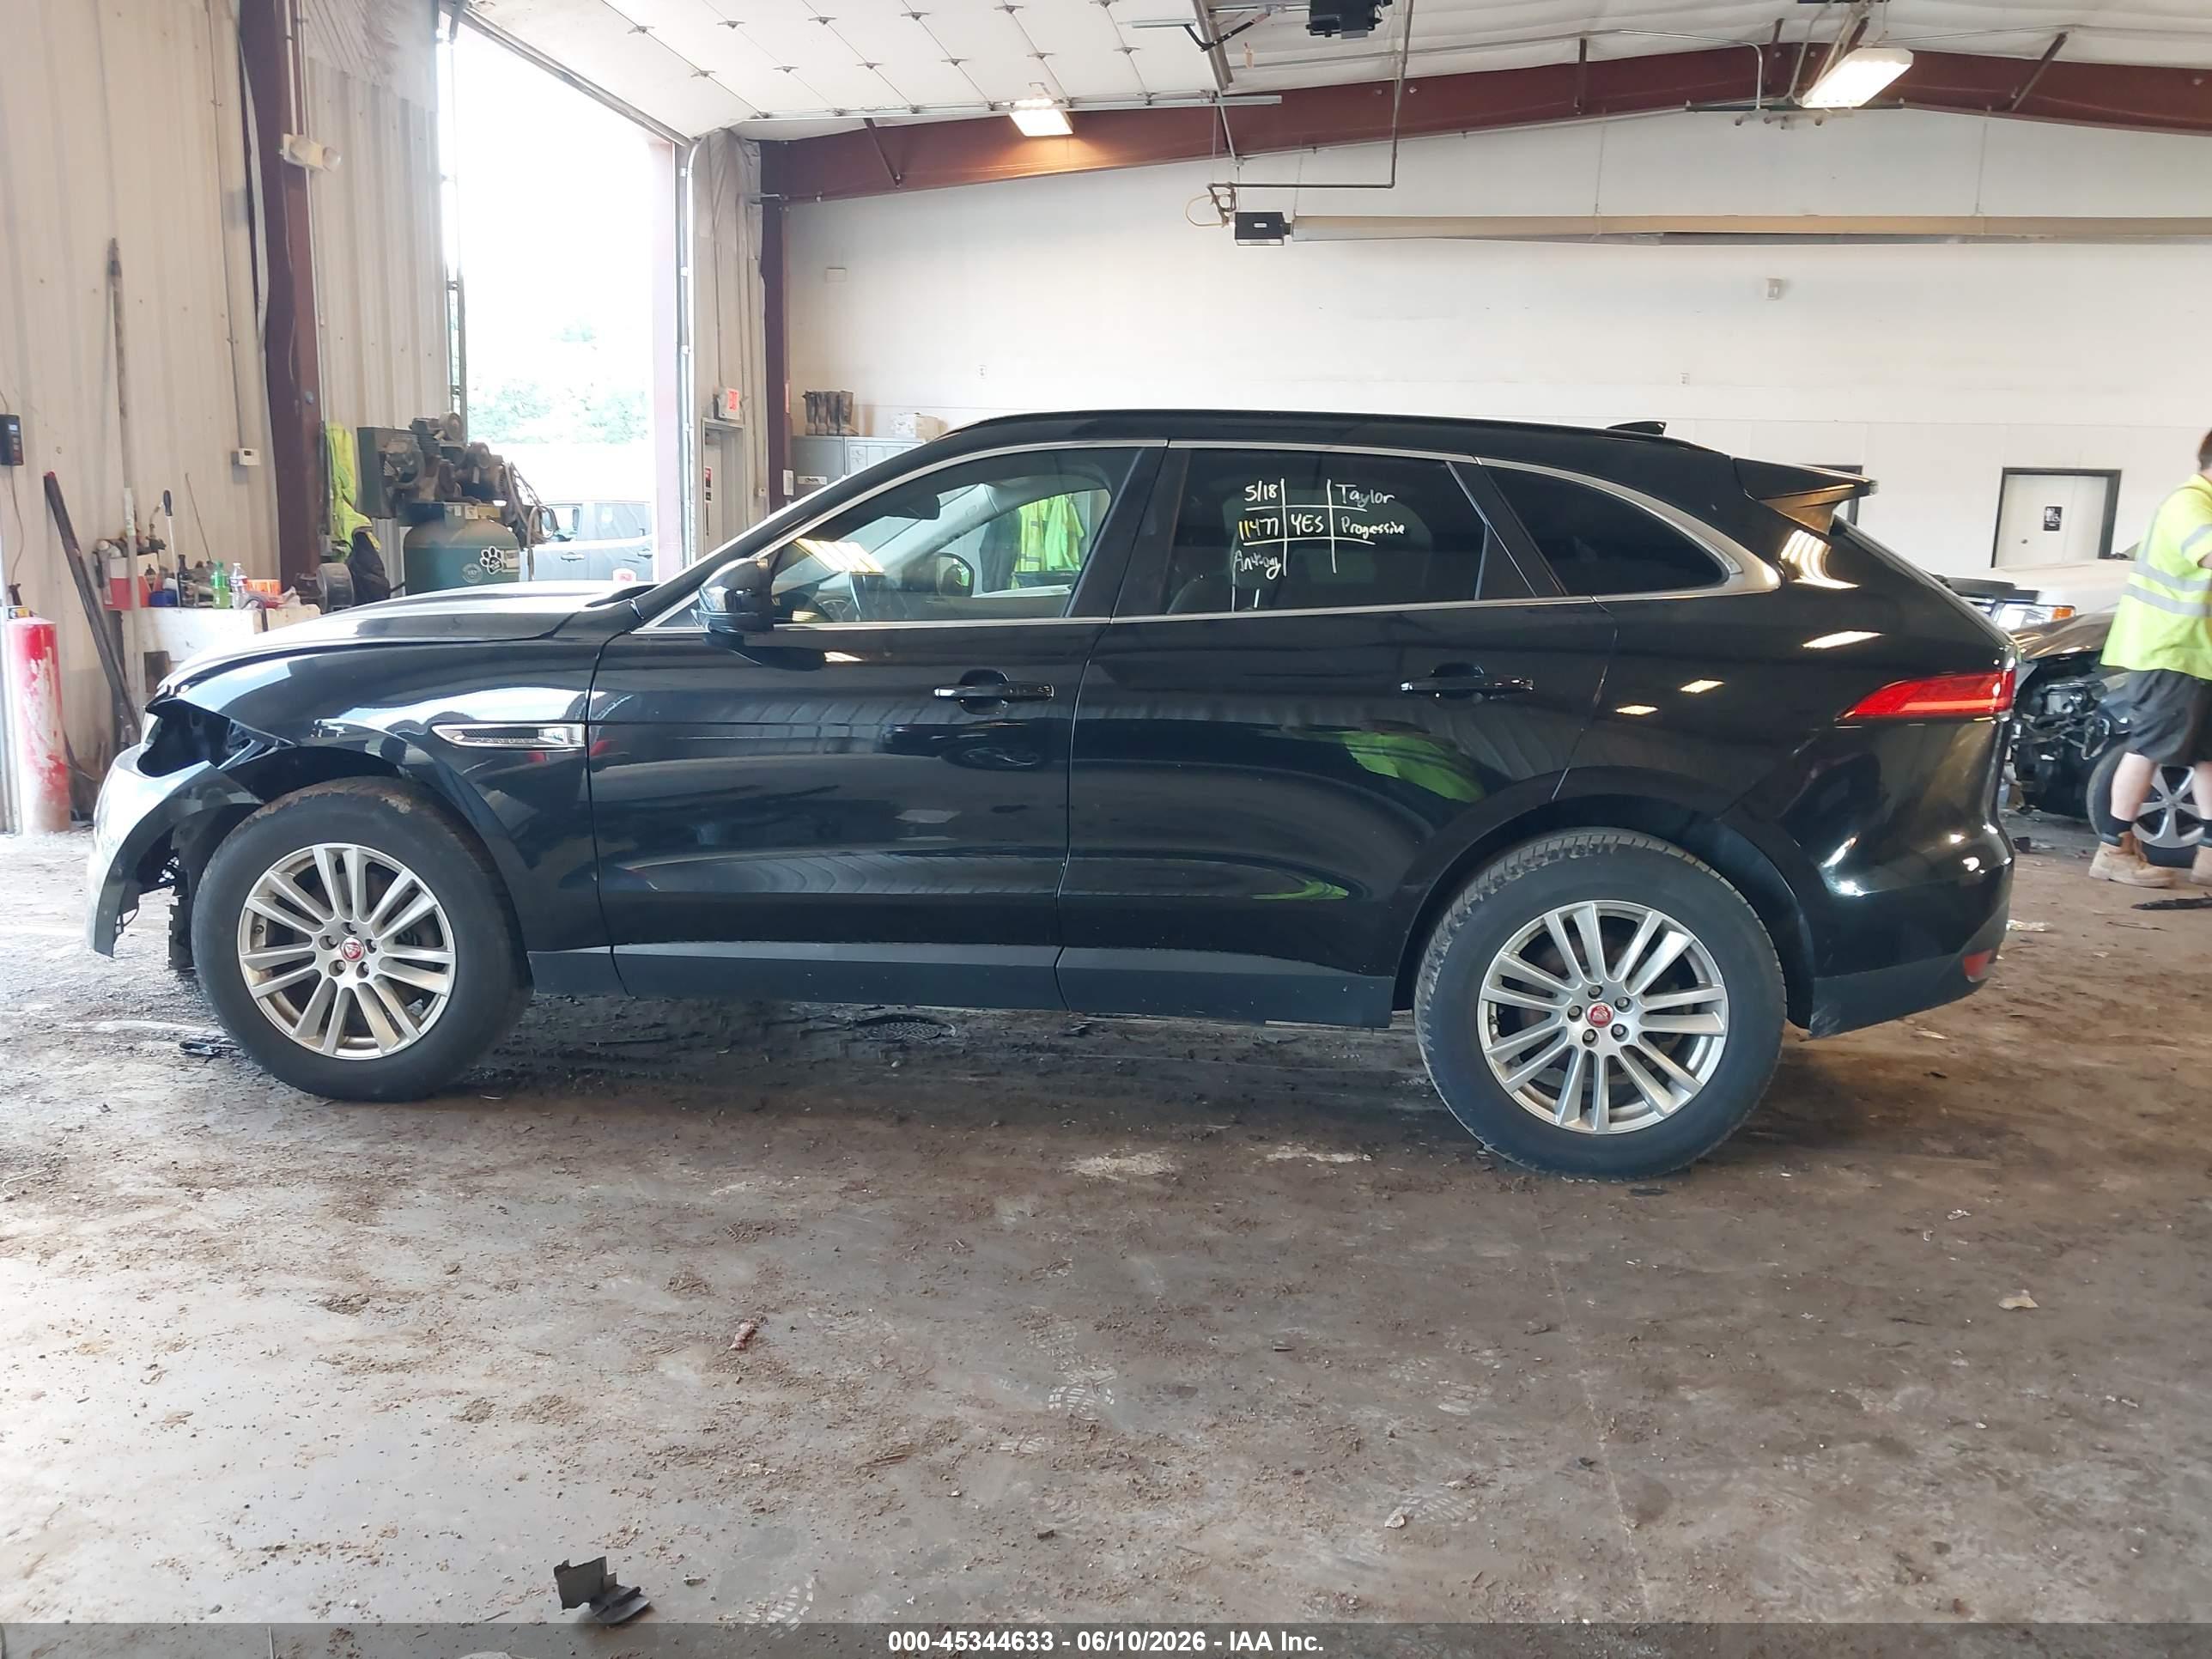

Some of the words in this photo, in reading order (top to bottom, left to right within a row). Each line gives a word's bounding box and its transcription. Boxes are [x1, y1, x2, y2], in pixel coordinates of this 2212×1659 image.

[1244, 480, 1279, 501] 5/18
[1334, 483, 1395, 507] Taylor
[1291, 514, 1324, 535] YES
